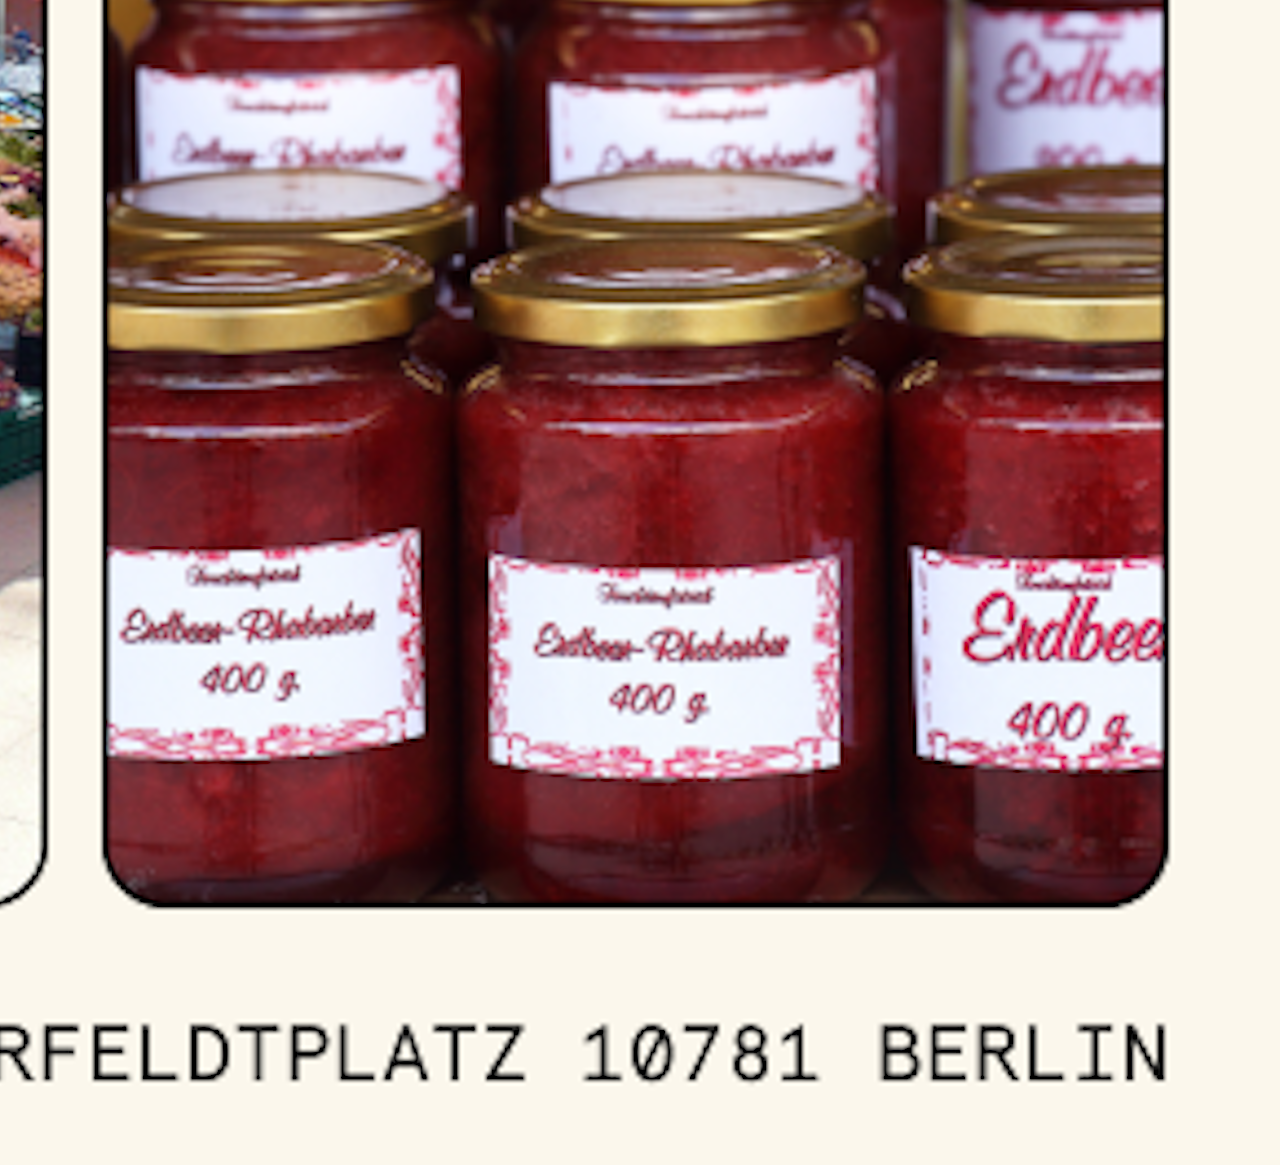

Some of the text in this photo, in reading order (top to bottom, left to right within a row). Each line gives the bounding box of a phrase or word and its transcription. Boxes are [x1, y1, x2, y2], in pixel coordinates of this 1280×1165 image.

[533, 621, 790, 664] Erdbeer-Rhabarber
[200, 661, 267, 694] 400
[608, 683, 676, 715] 400
[1006, 700, 1089, 742] 400
